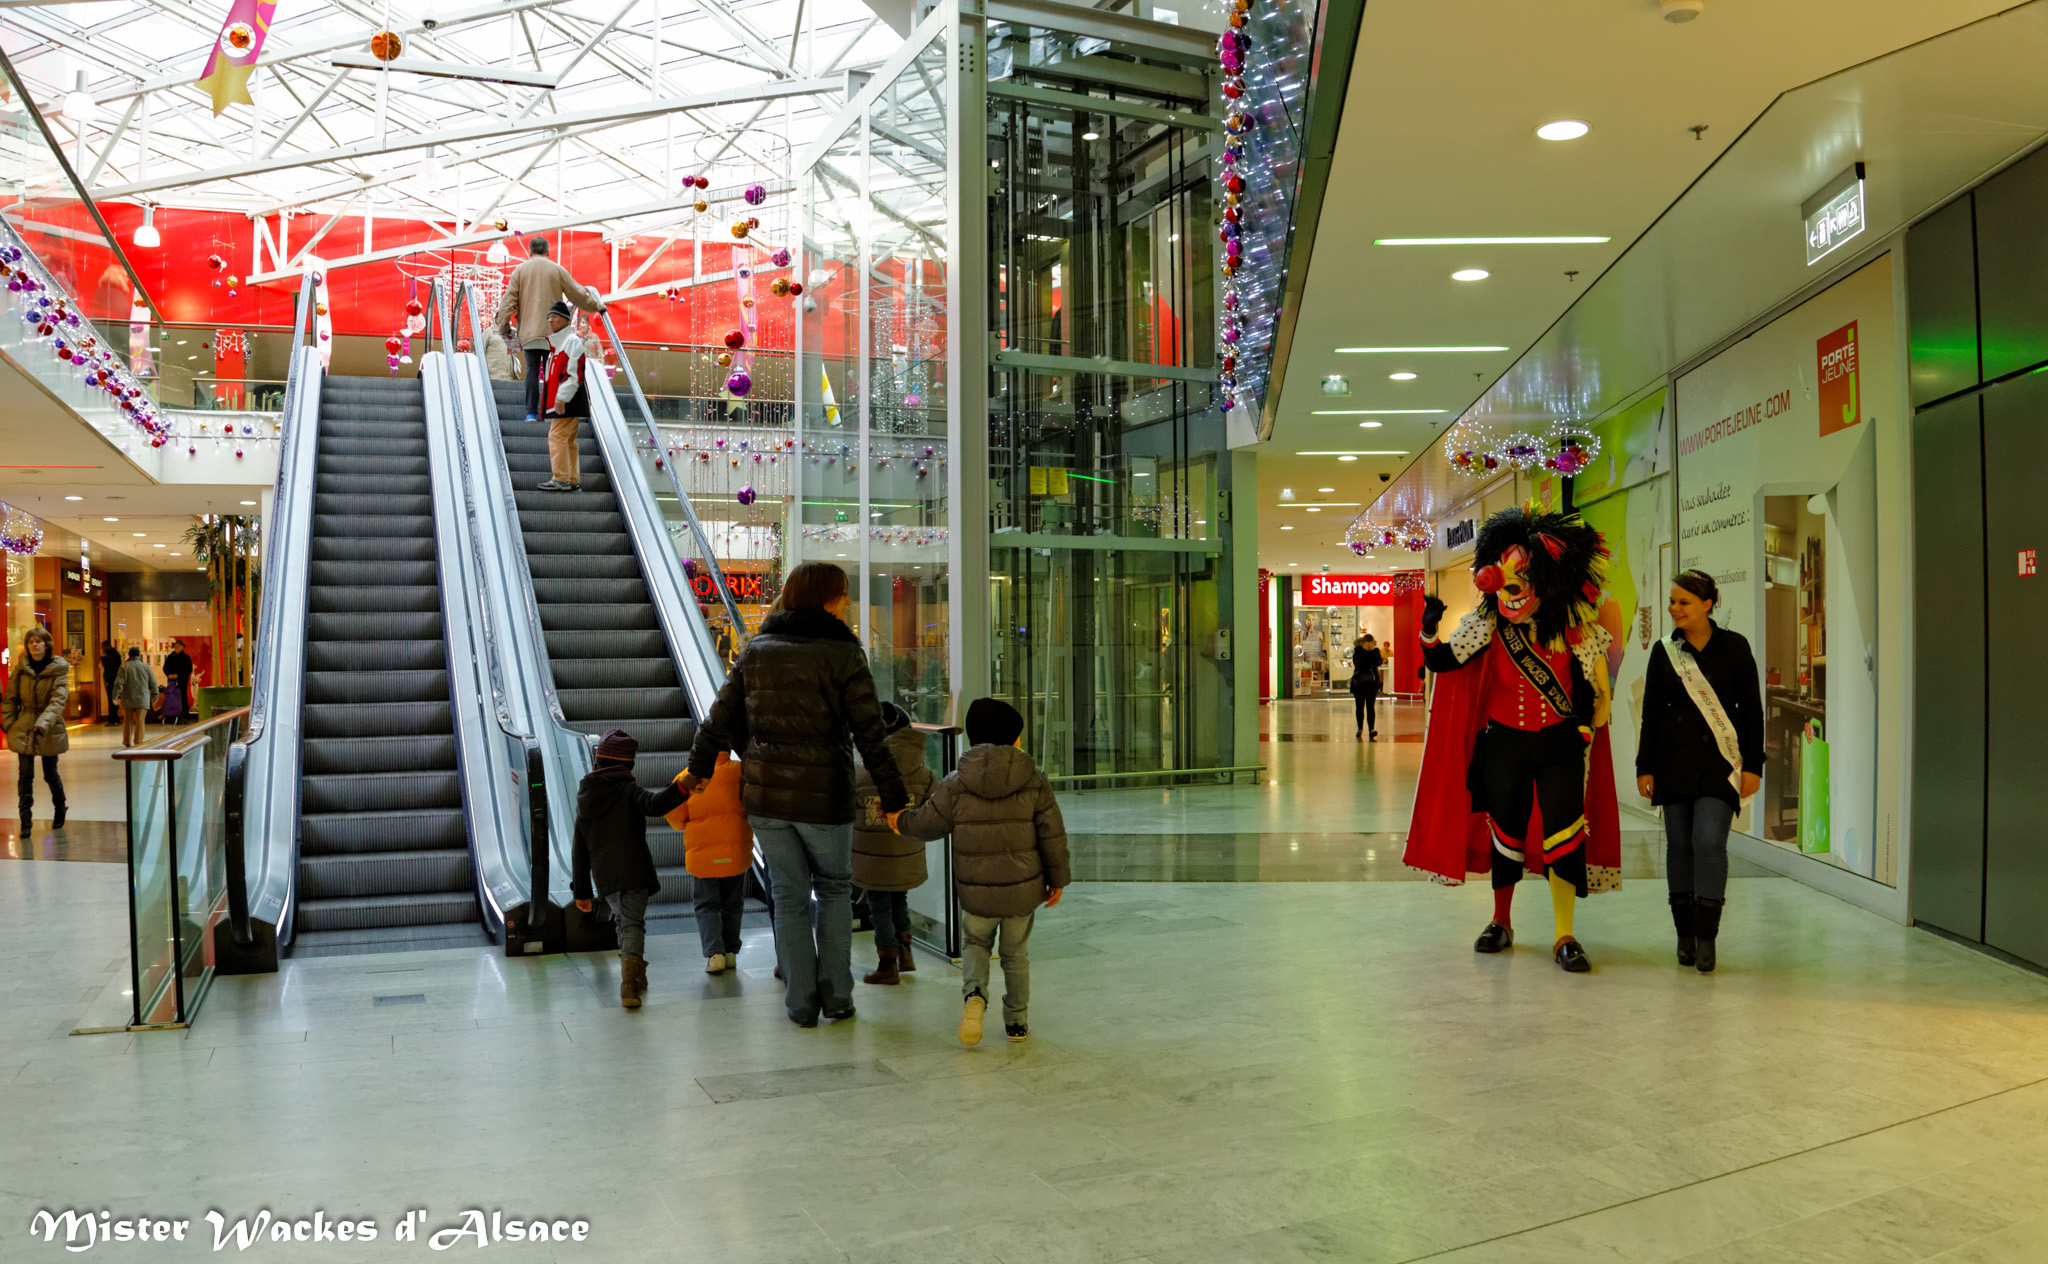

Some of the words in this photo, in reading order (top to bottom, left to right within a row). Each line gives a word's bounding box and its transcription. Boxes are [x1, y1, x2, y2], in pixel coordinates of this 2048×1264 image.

[1821, 342, 1855, 370] PORTE
[1821, 357, 1856, 384] JEUNE
[1311, 576, 1391, 599] Shampoo
[1520, 655, 1550, 685] WACKES
[1697, 690, 1714, 706] MISS
[1709, 707, 1728, 733] RONDE
